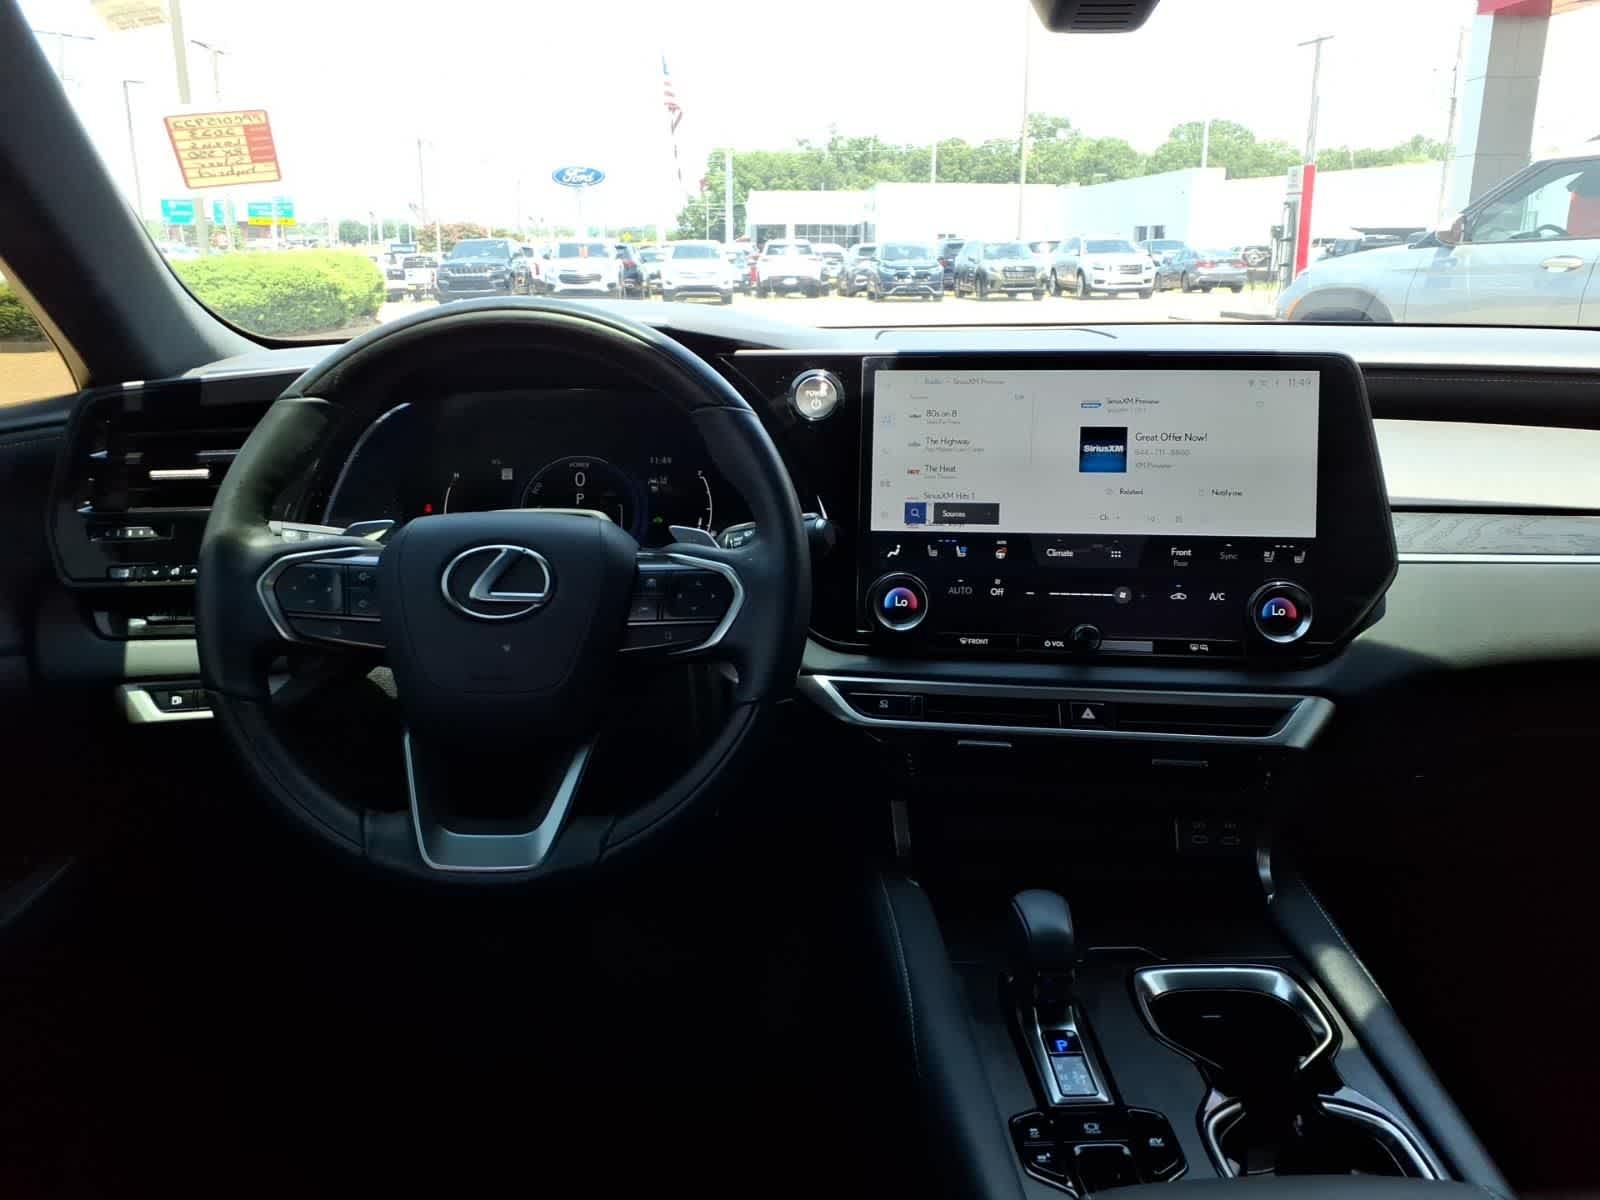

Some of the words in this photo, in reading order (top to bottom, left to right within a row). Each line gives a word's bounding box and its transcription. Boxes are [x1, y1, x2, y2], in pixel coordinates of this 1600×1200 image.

[562, 166, 593, 184] Ford
[926, 437, 939, 446] The
[940, 436, 970, 447] Highway
[1135, 432, 1159, 442] Great
[1160, 432, 1183, 442] Offer
[1184, 432, 1208, 442] Now!
[1083, 444, 1124, 454] SiriusXM
[924, 465, 938, 473] The
[939, 465, 957, 473] Heat
[575, 492, 585, 505] P
[942, 509, 966, 519] Sources
[1046, 548, 1074, 558] Climate
[1170, 547, 1192, 557] Front
[1219, 551, 1239, 562] Sync
[948, 586, 973, 596] AUTO
[990, 587, 1005, 597] Off
[895, 596, 908, 608] Lo
[1209, 592, 1226, 602] A/C
[1272, 604, 1286, 617] Lo
[968, 637, 989, 646] FRONT
[1052, 640, 1065, 648] VOL
[1056, 1039, 1068, 1052] P
